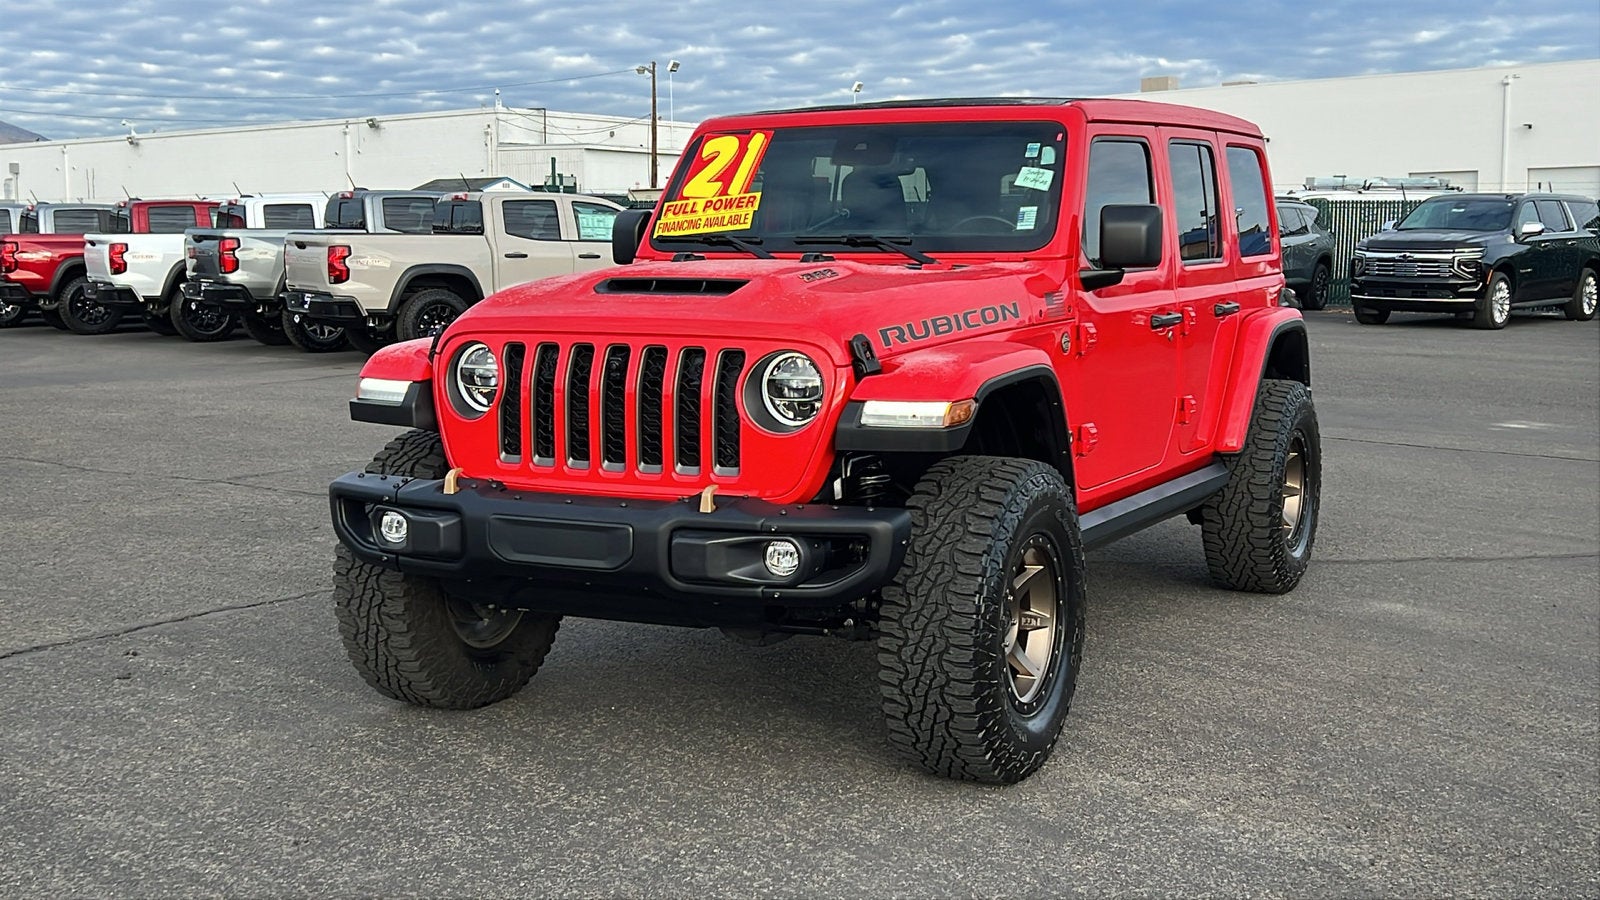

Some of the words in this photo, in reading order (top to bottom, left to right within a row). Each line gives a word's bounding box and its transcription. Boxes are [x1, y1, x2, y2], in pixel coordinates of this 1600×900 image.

[682, 132, 767, 198] 21
[663, 202, 698, 217] FULL
[702, 195, 757, 212] POWER
[657, 219, 701, 234] FINANCING
[703, 213, 749, 228] AVAILABLE
[878, 302, 1020, 348] RUBICON
